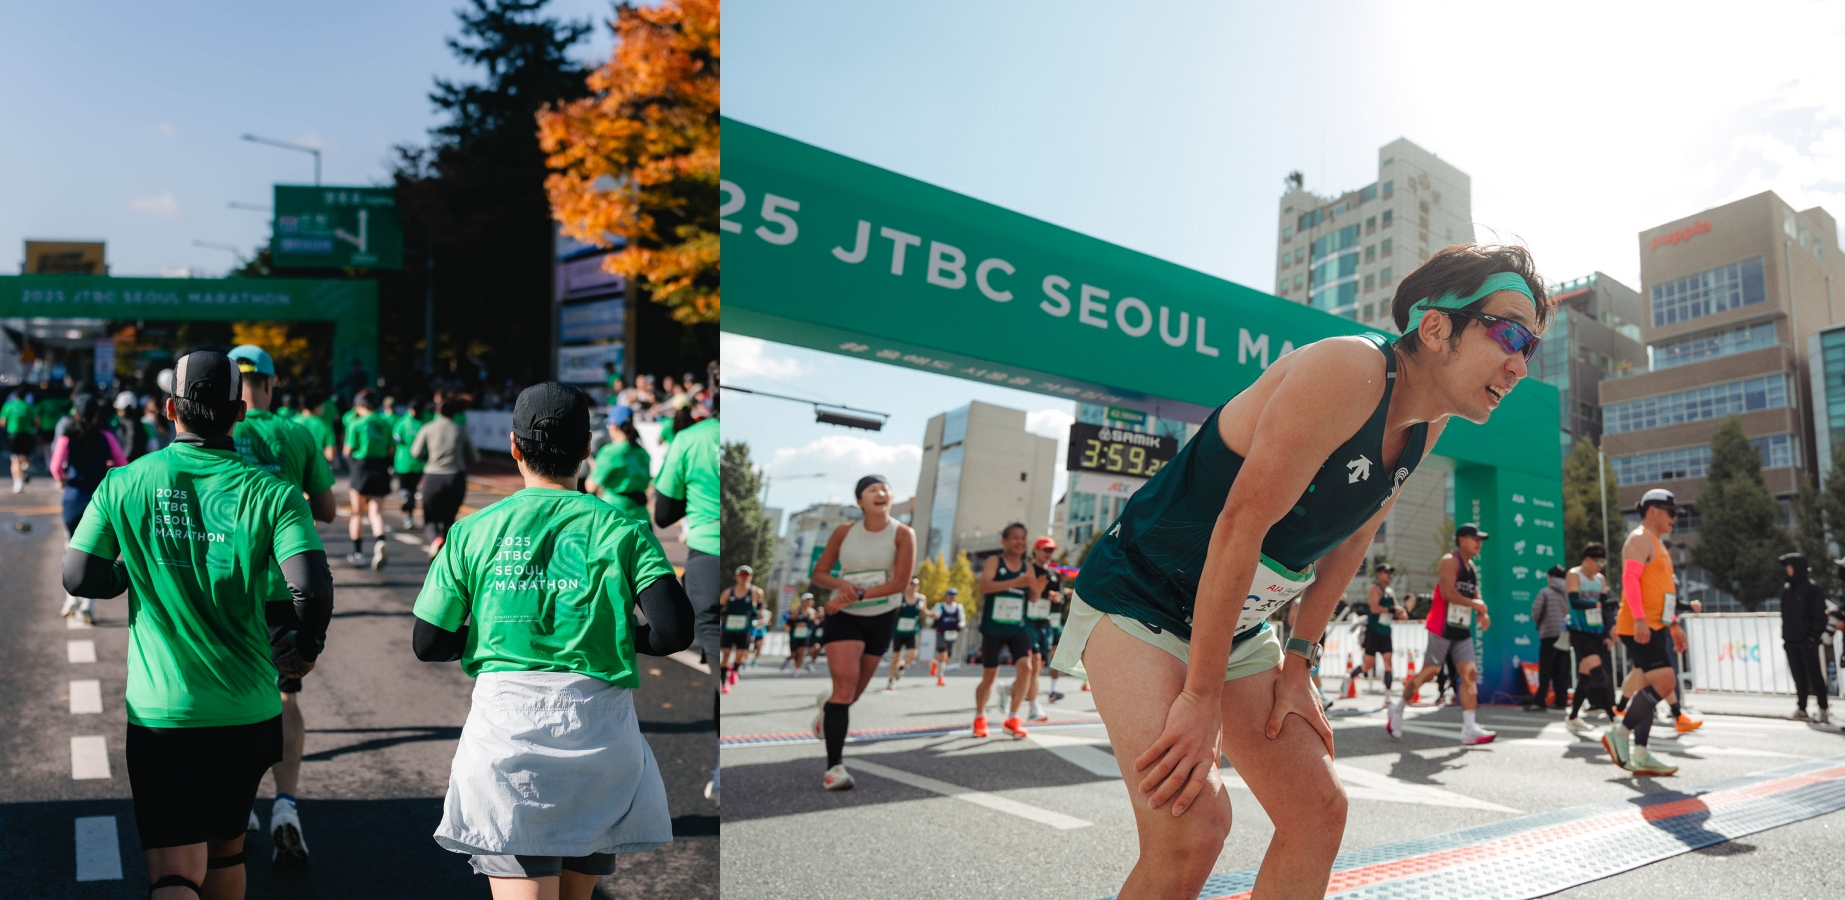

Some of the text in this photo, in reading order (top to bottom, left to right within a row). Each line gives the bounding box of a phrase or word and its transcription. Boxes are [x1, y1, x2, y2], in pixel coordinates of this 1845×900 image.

[831, 219, 1017, 303] JTBC
[1039, 274, 1220, 358] SEOUL
[155, 488, 188, 500] 2025
[155, 501, 189, 513] JTBC
[155, 514, 196, 528] SEOUL
[155, 528, 226, 543] MARATHON
[495, 536, 531, 548] 2025
[495, 550, 532, 561] JTBC
[494, 565, 543, 576] SEOUL
[494, 578, 579, 592] MARATHON
